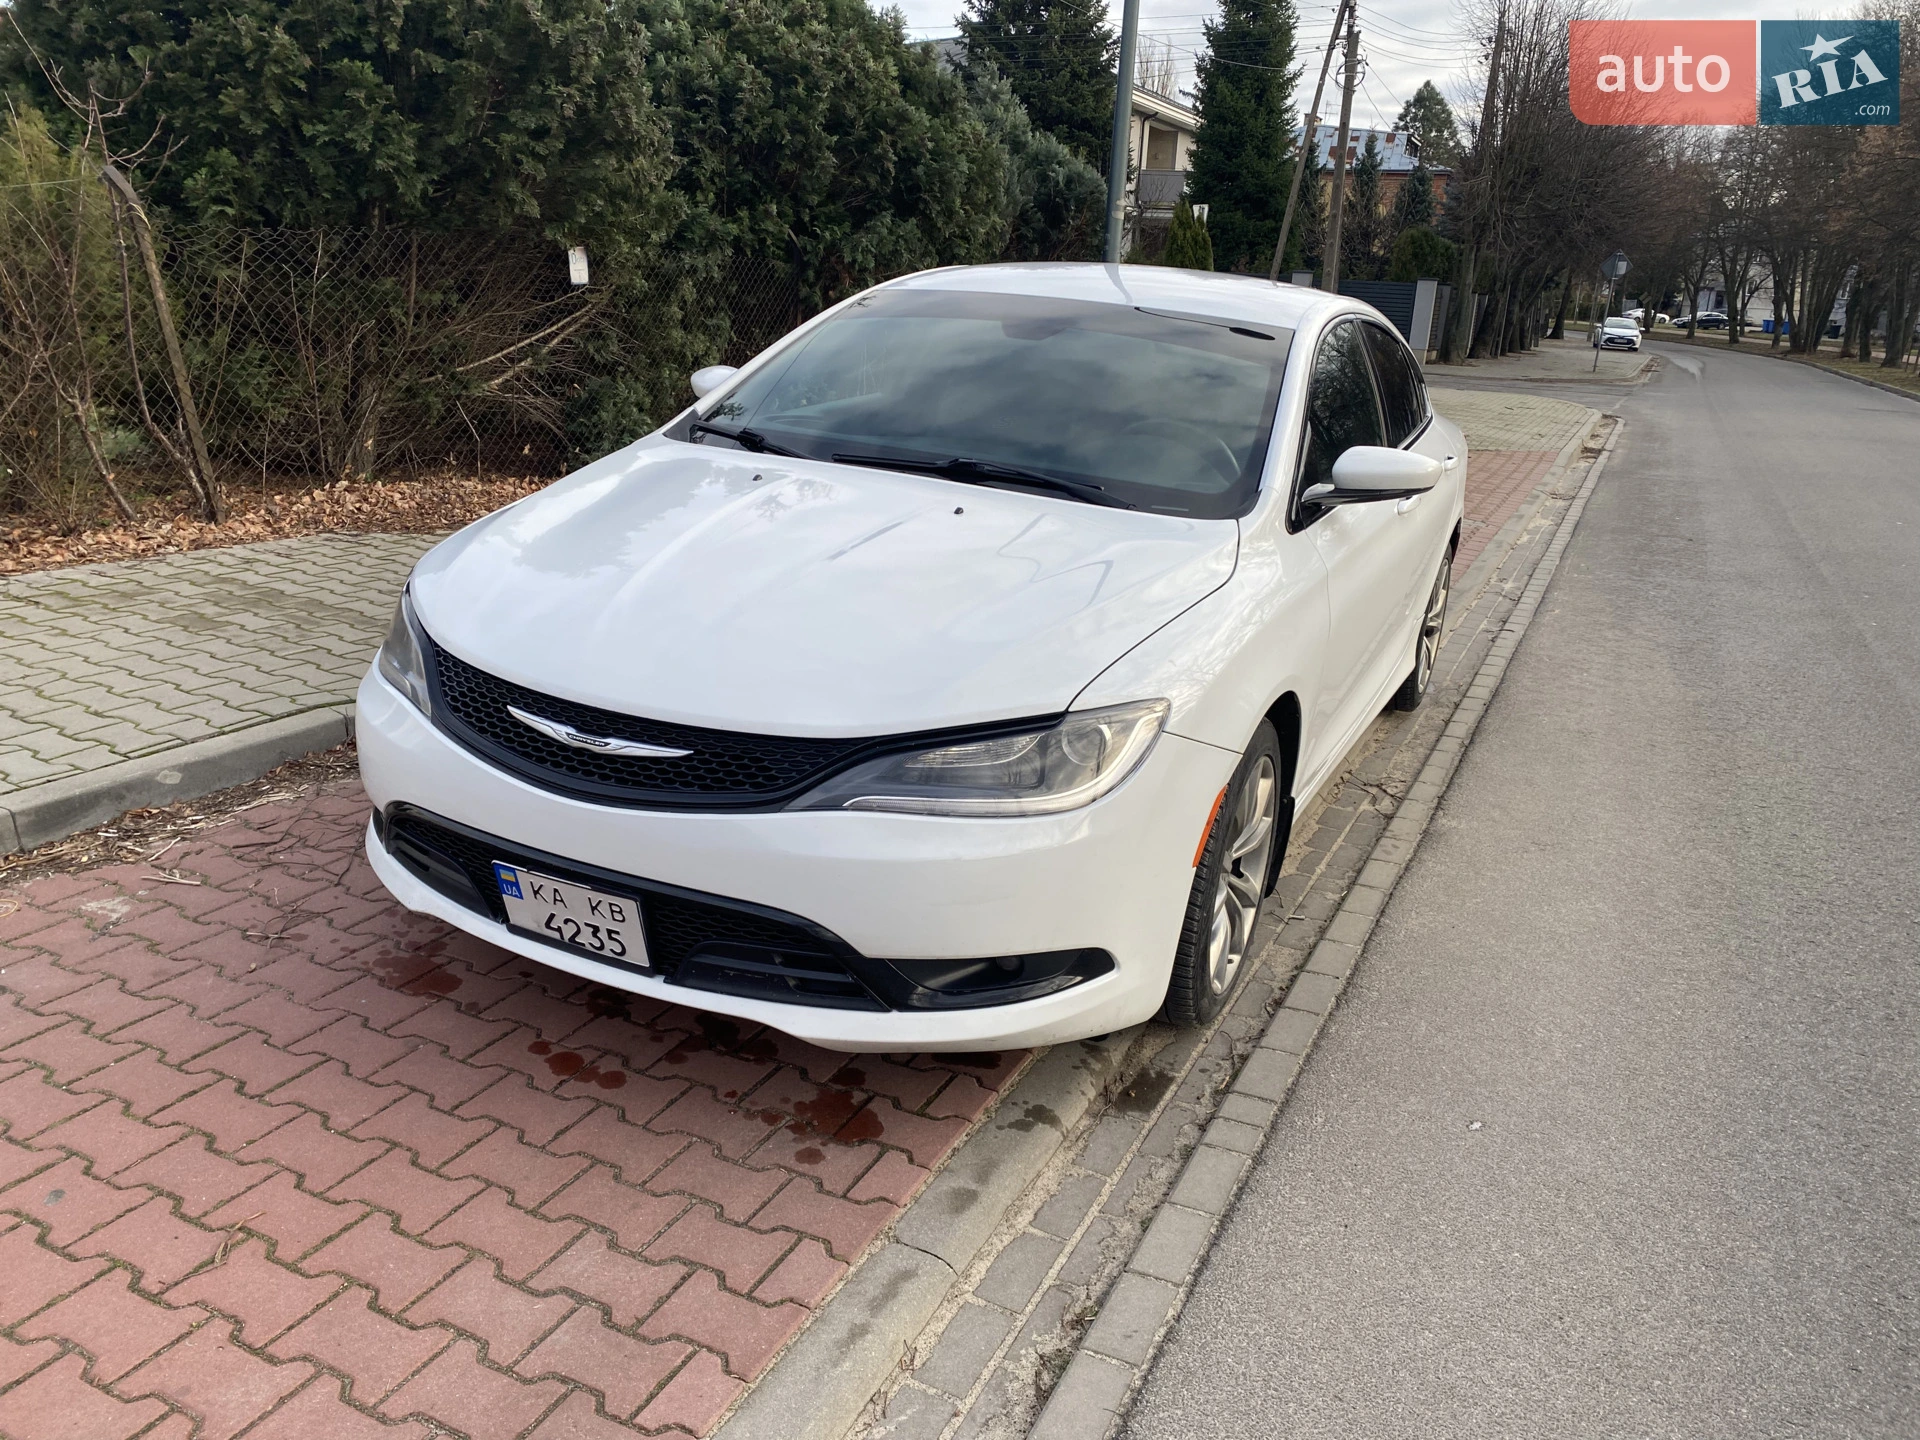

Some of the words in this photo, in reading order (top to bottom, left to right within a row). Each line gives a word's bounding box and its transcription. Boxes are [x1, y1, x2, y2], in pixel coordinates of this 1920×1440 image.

[568, 734, 605, 746] CHRYSLER
[503, 883, 520, 897] UA
[530, 880, 568, 909] KA
[587, 896, 626, 923] KB
[544, 912, 627, 957] 4235
